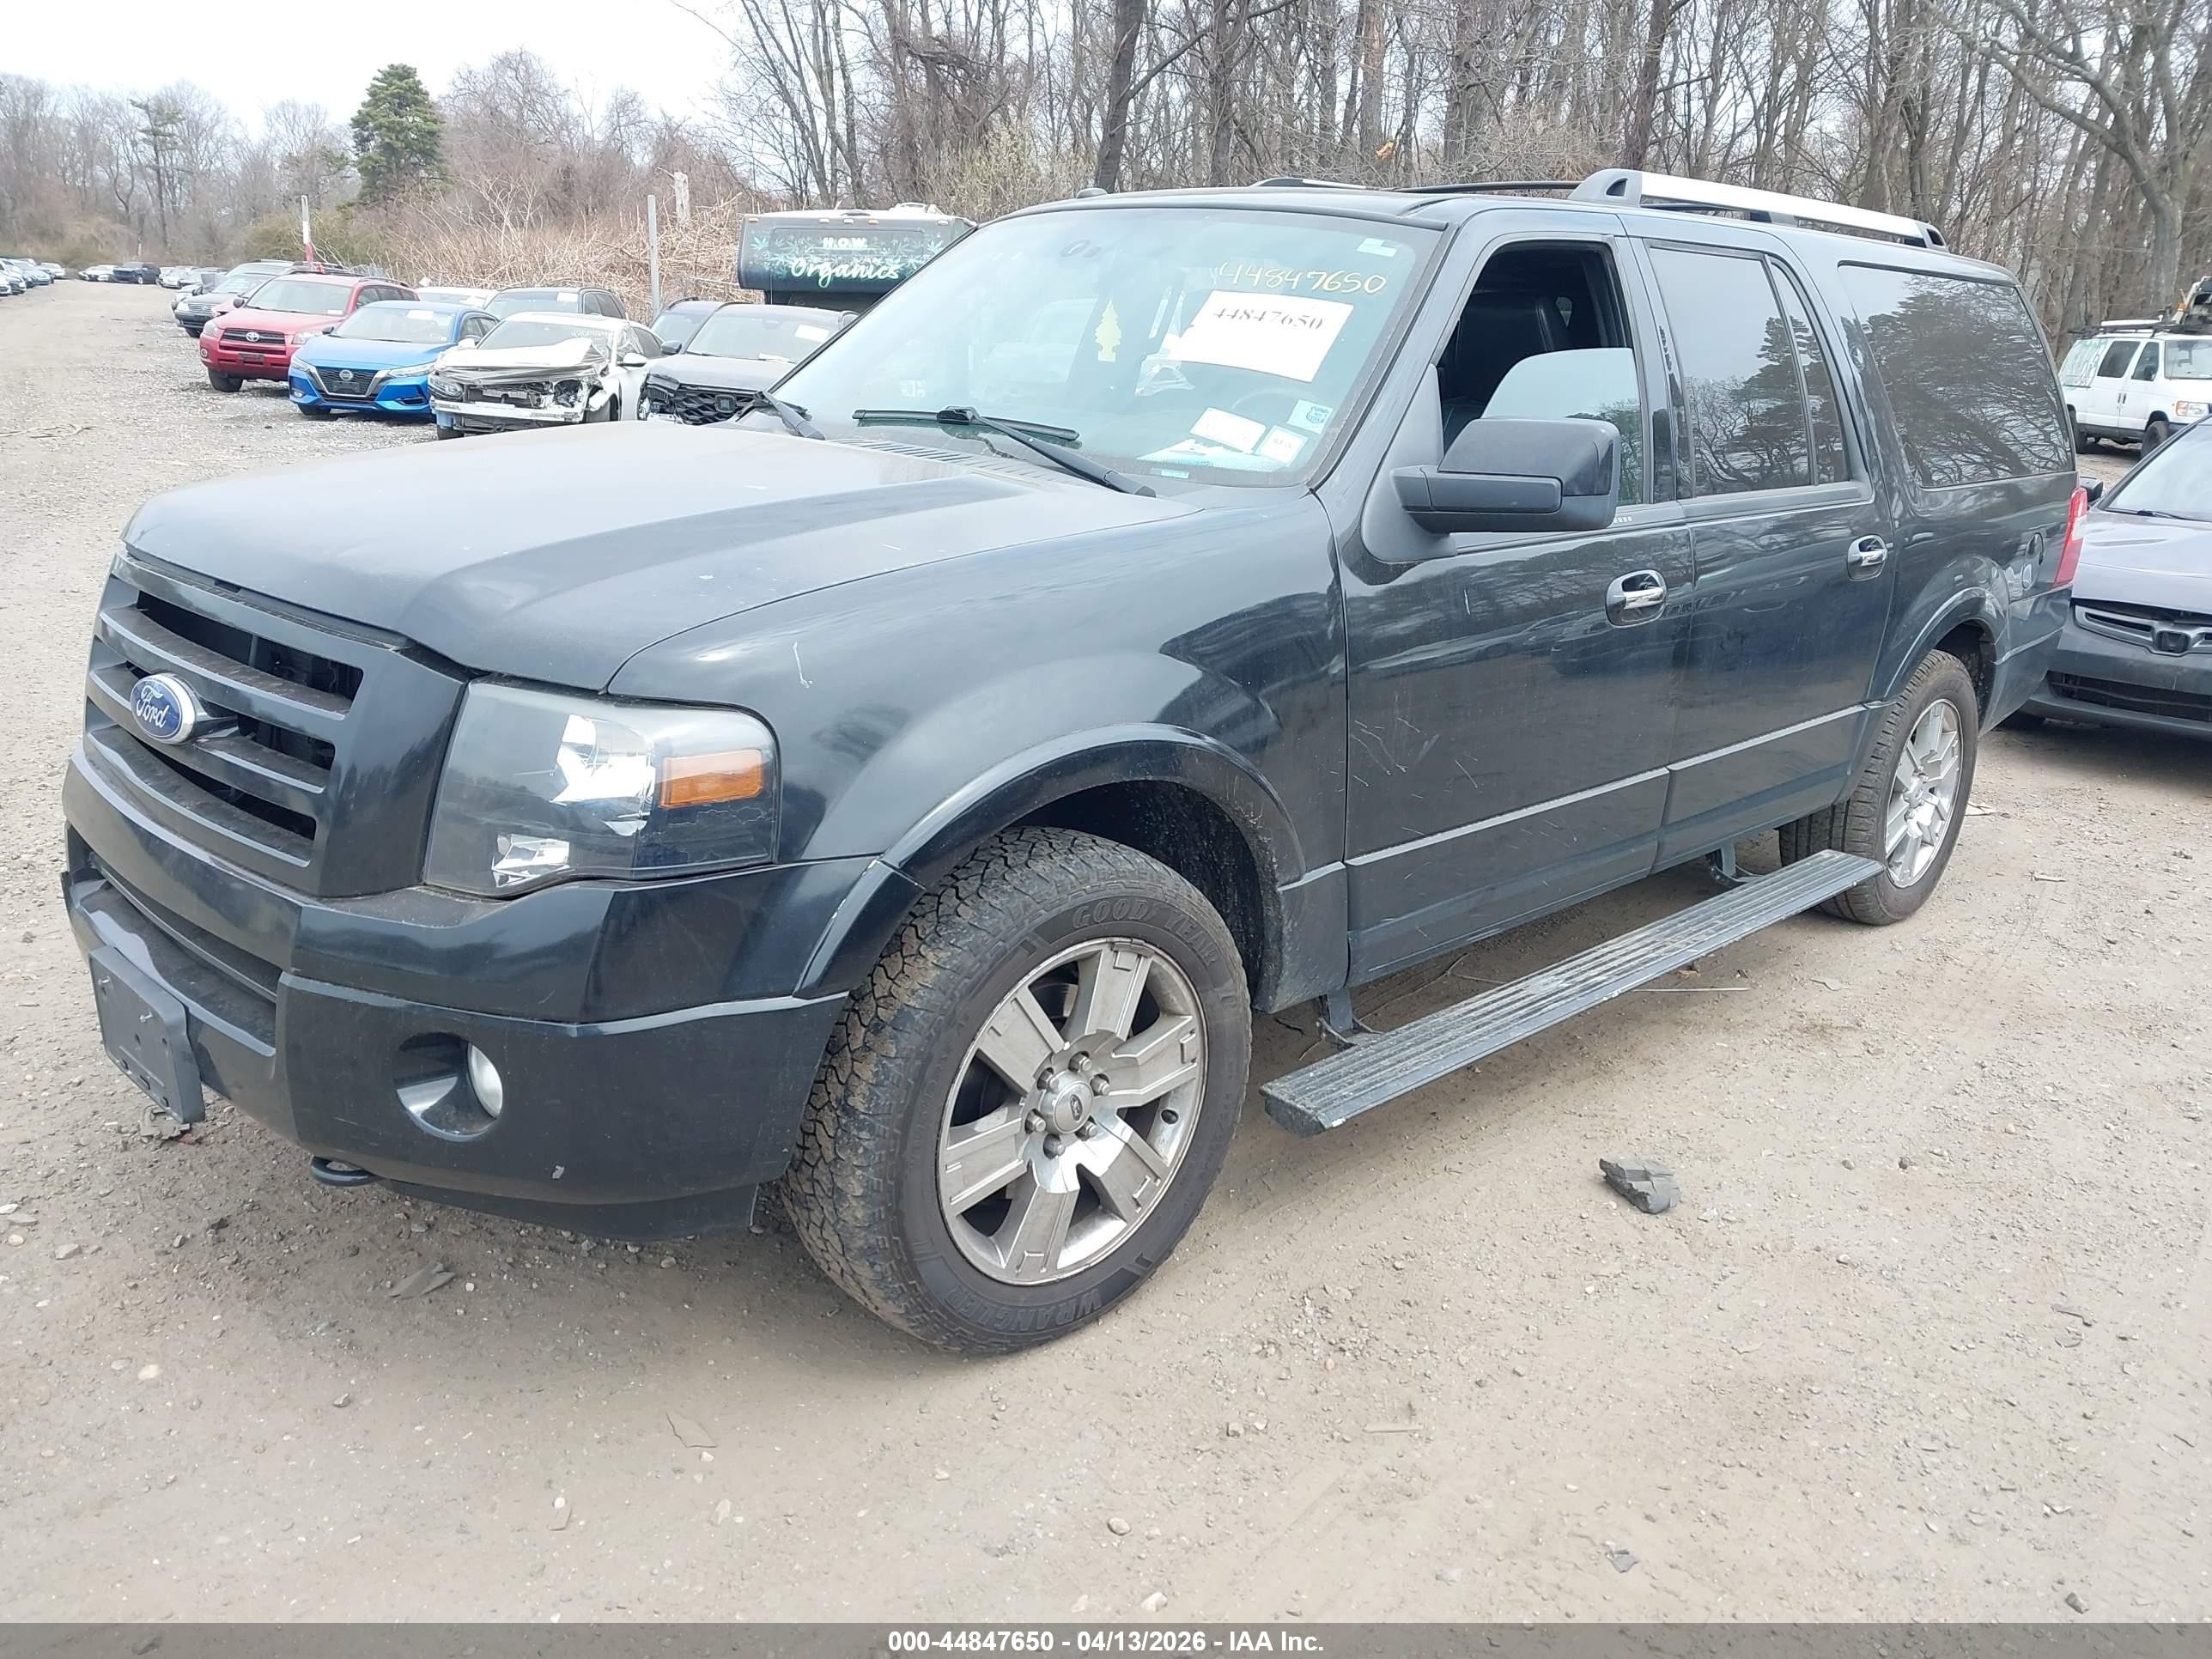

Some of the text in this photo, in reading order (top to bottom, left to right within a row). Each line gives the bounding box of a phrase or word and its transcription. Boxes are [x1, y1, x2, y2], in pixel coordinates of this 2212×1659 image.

[791, 257, 901, 289] Organics
[1218, 261, 1387, 294] 44847650
[1213, 307, 1324, 331] 44847650
[136, 684, 170, 728] Ford
